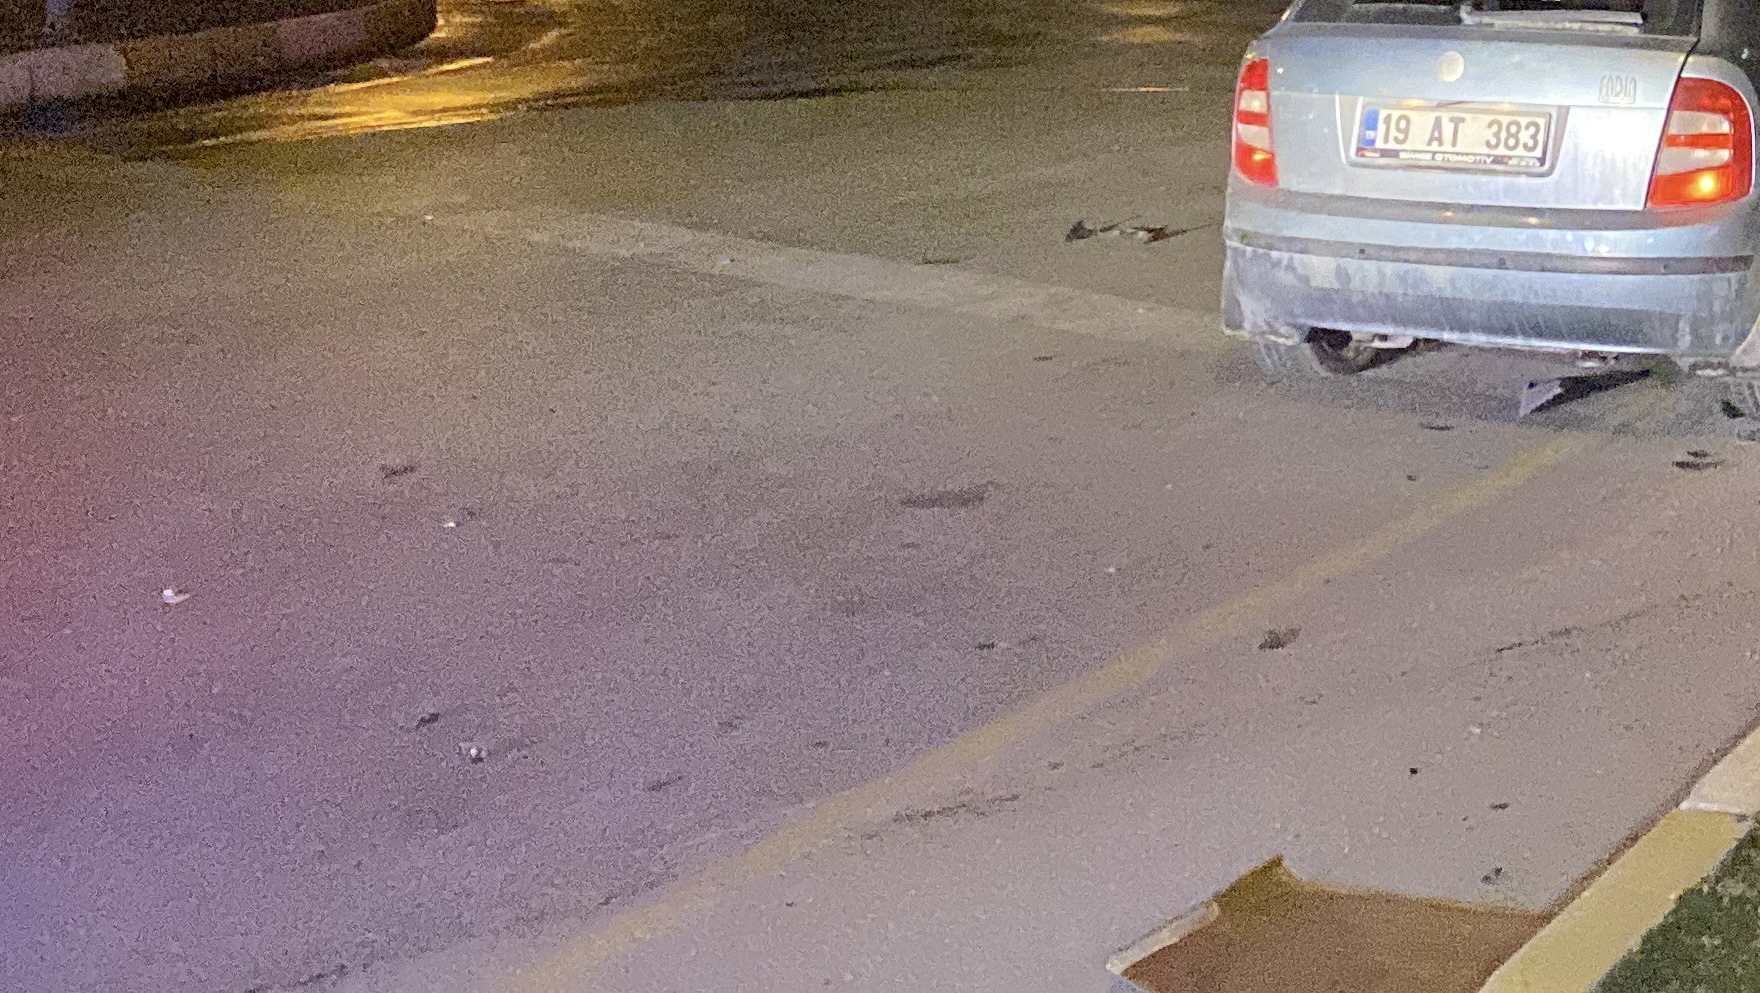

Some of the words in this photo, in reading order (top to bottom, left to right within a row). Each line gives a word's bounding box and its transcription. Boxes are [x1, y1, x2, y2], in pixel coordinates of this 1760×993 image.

[1382, 113, 1411, 145] 19
[1426, 115, 1466, 148] AT
[1485, 118, 1542, 153] 383
